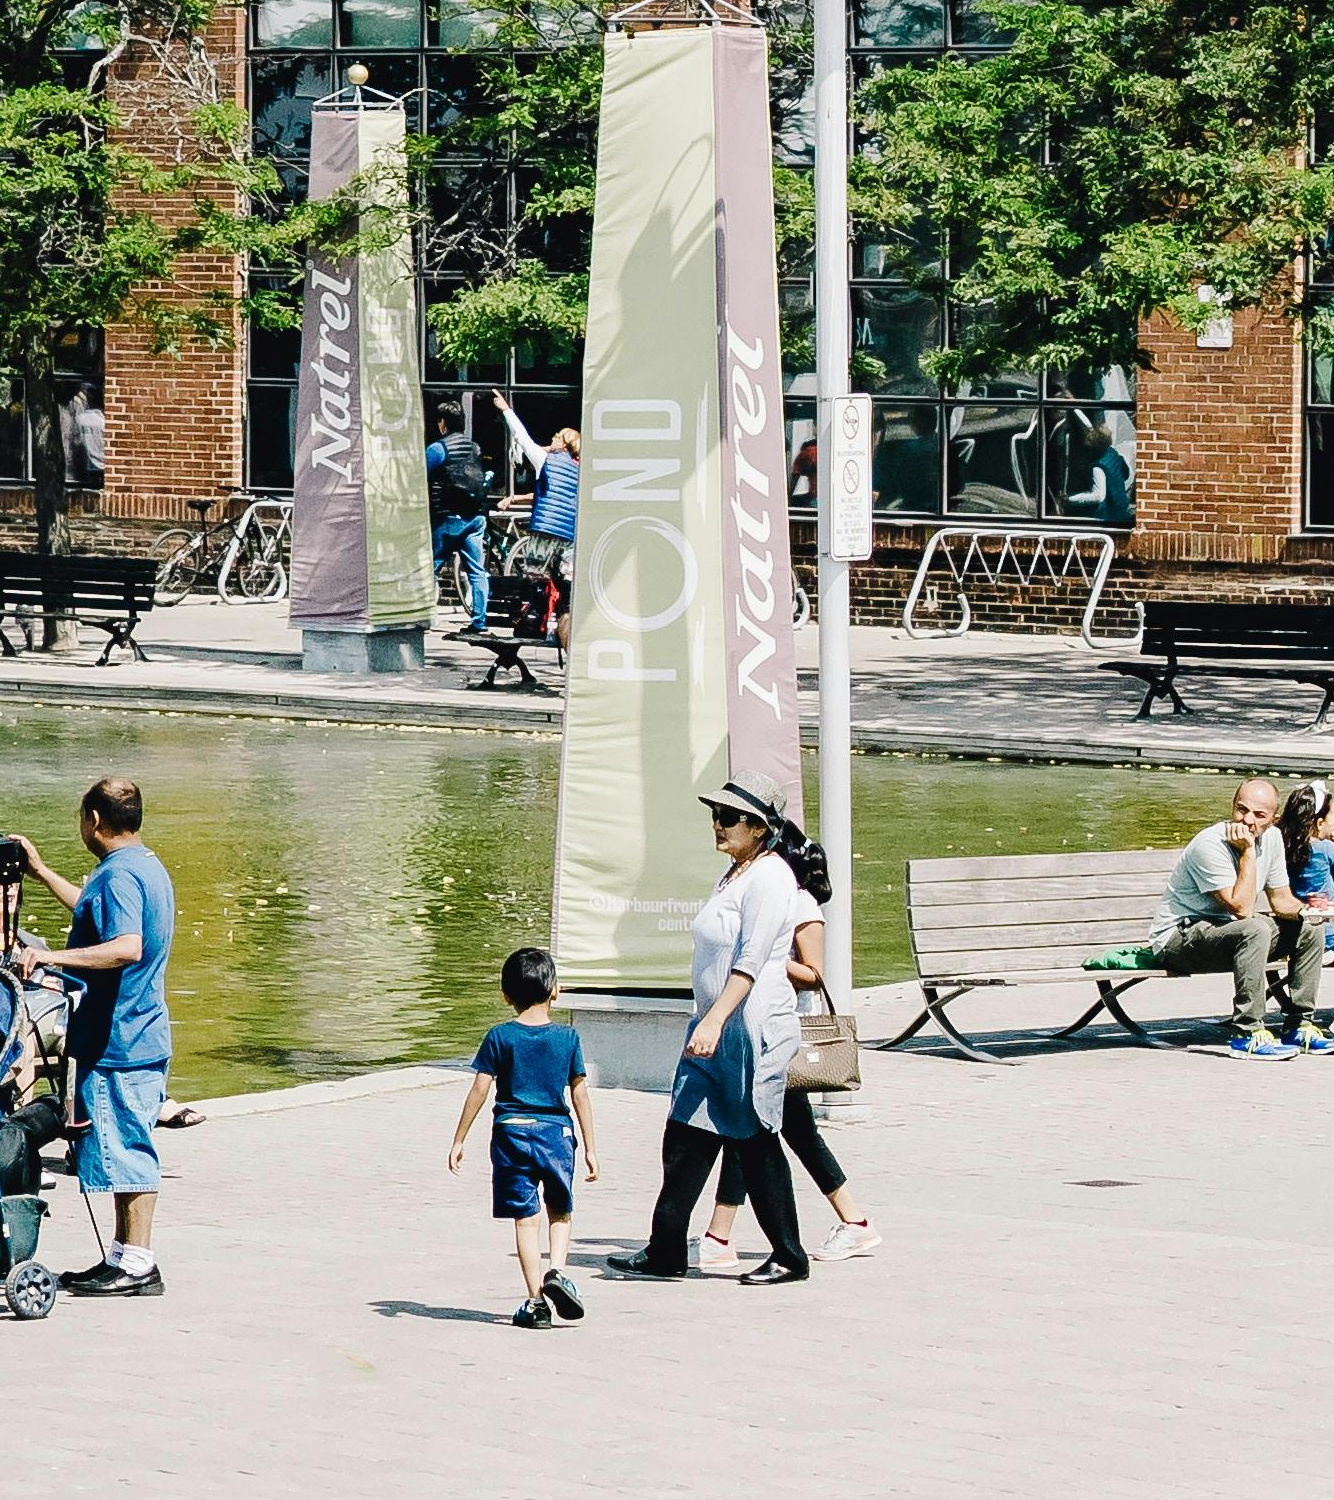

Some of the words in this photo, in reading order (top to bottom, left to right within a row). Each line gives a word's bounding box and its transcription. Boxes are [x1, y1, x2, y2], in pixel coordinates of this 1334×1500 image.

[311, 269, 352, 484] Natrel
[587, 398, 698, 683] POND
[726, 322, 782, 722] Natrel
[607, 896, 707, 915] Harbourfront
[658, 916, 693, 932] cent
